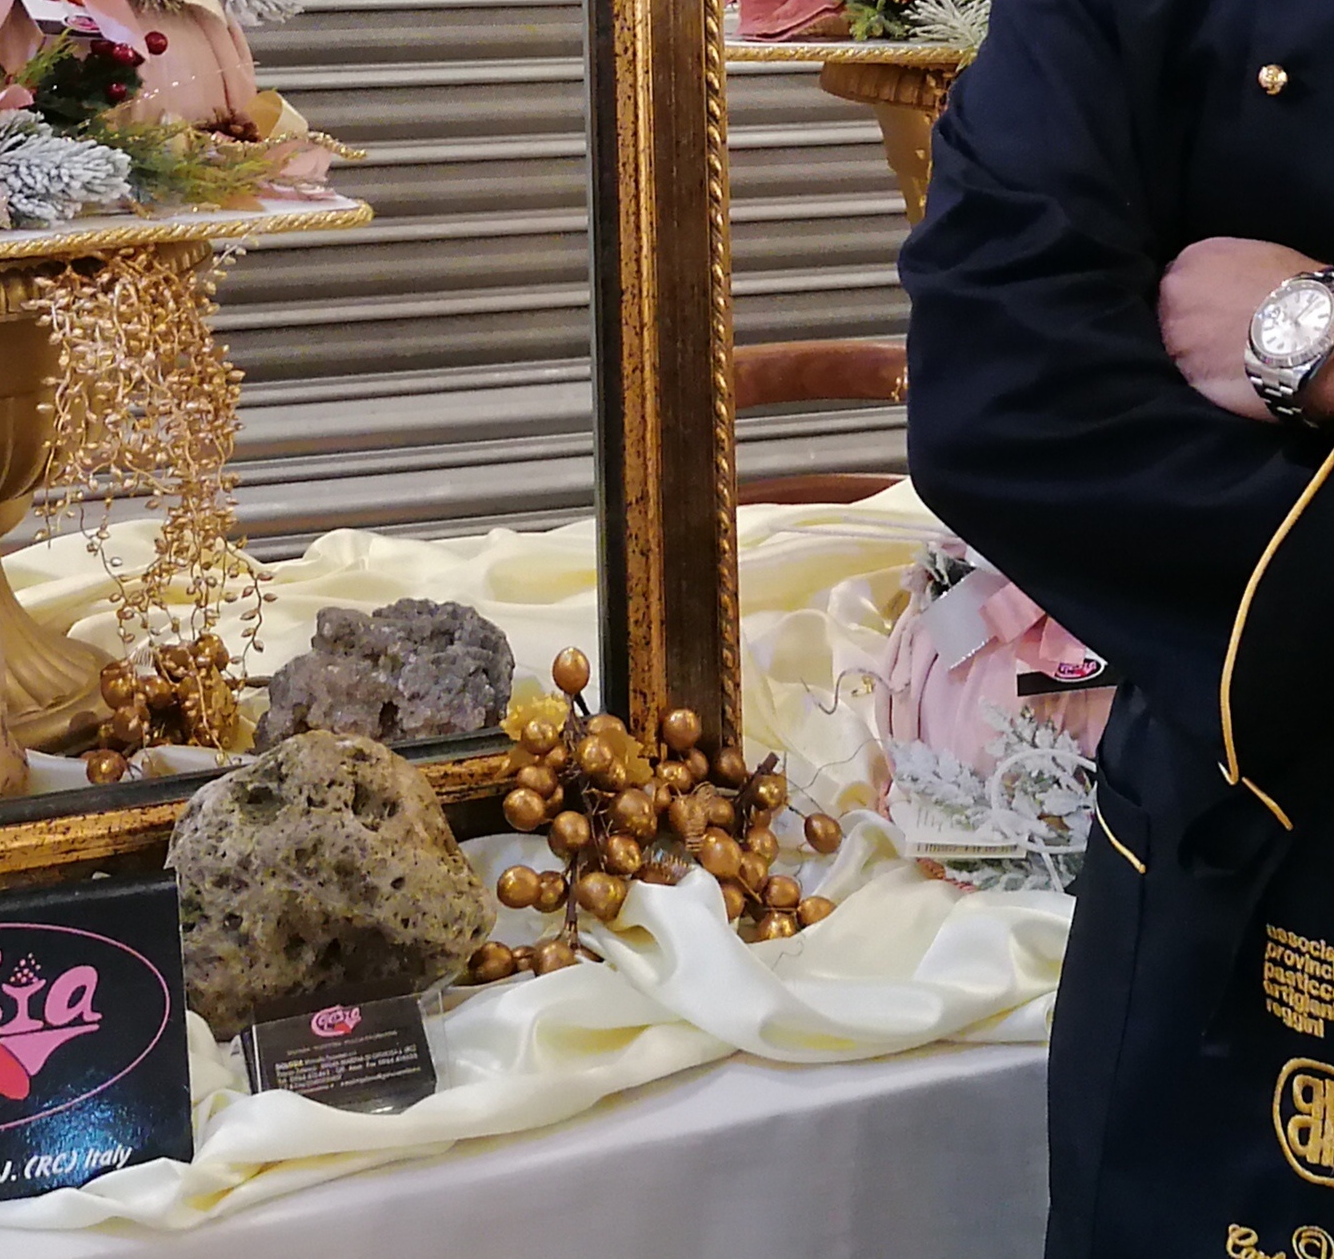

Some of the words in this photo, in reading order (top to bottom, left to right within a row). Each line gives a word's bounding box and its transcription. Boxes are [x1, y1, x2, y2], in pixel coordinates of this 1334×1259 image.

[1266, 998, 1325, 1039] reggini
[23, 1152, 77, 1180] (RC)
[83, 1144, 133, 1169] Italy
